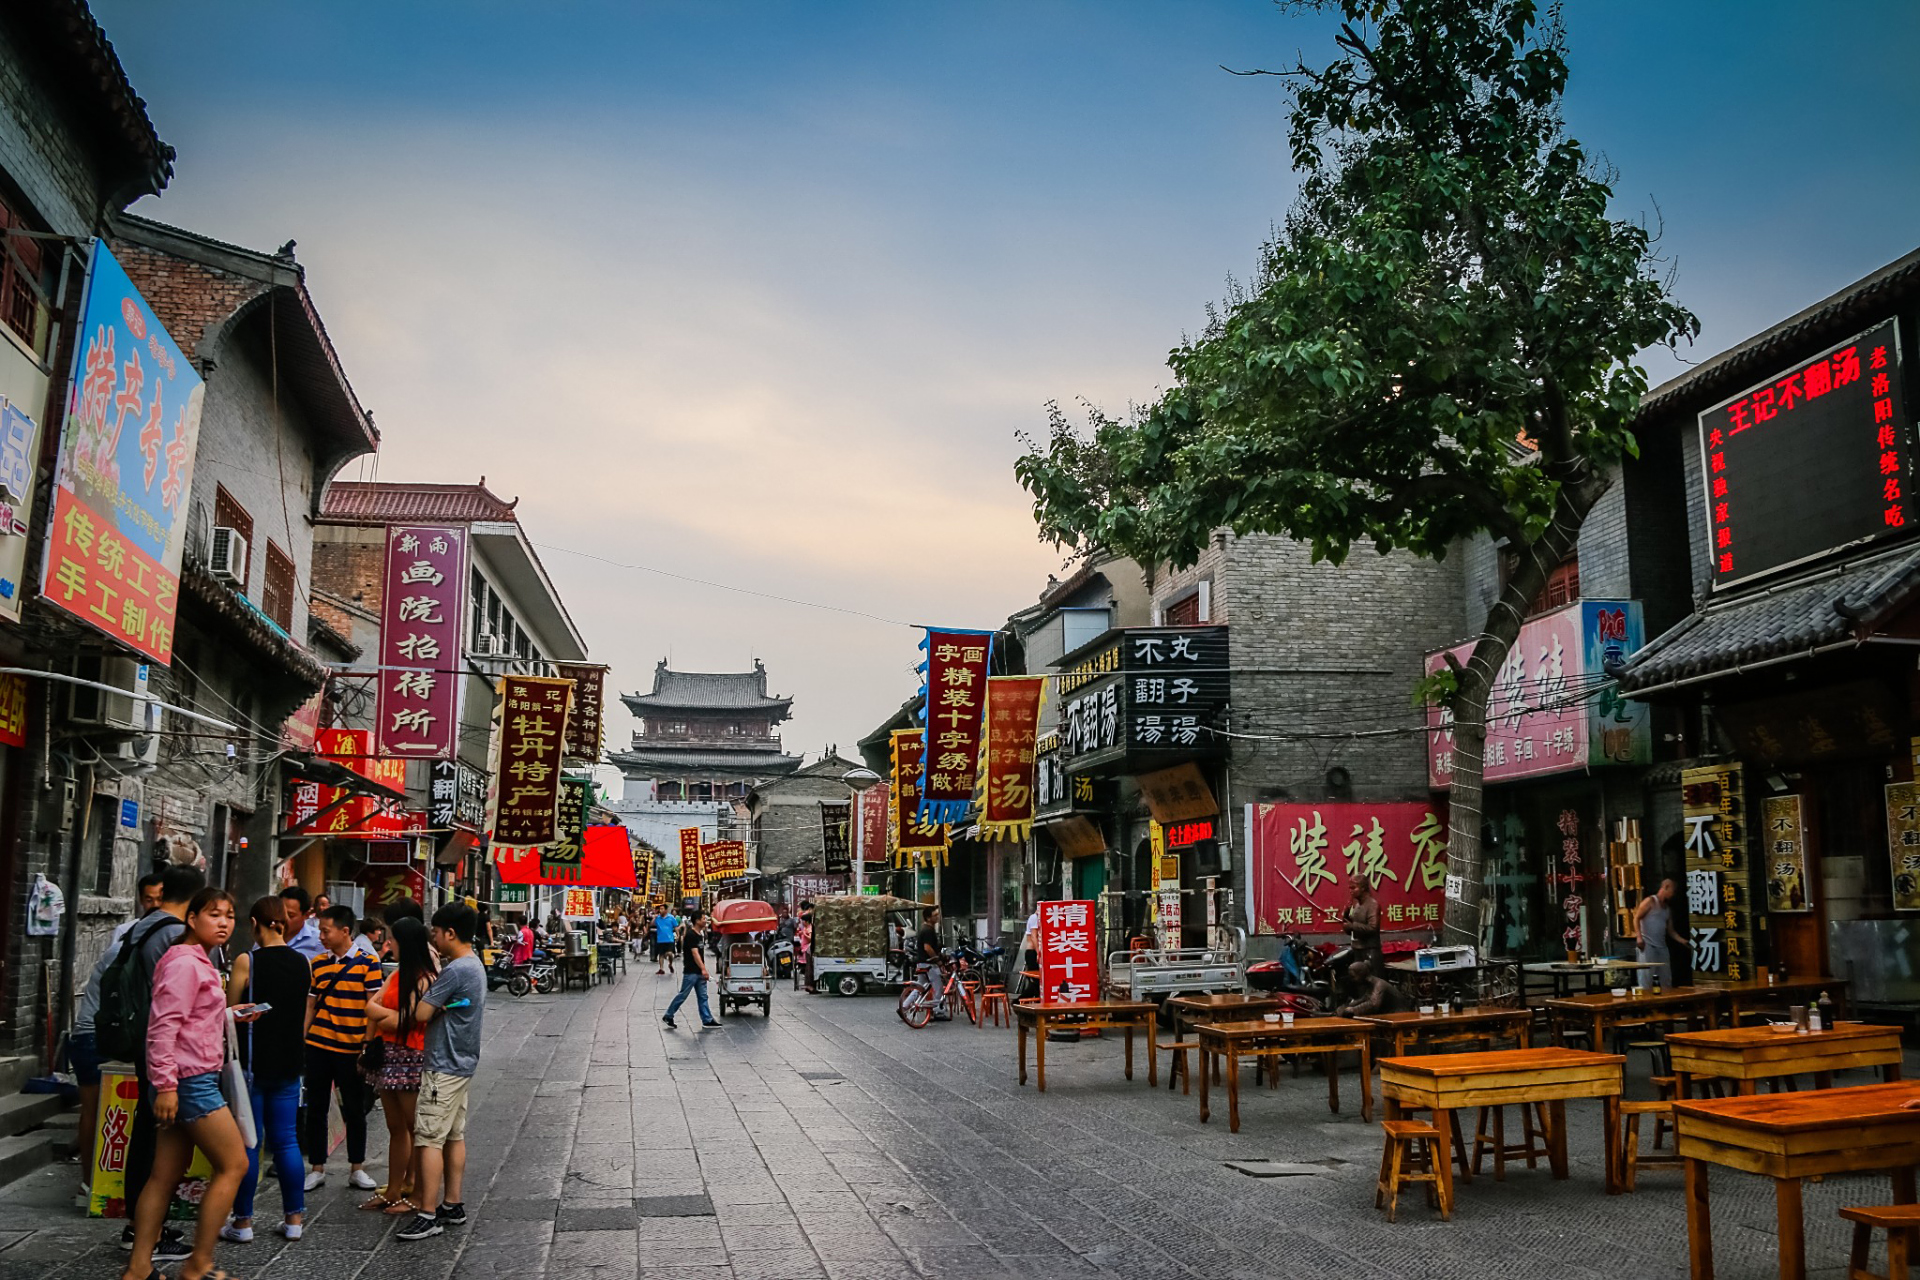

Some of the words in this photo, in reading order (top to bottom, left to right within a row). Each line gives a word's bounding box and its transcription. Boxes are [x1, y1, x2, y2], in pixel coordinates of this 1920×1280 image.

[80, 322, 188, 521] 特产专卖
[1727, 346, 1862, 437] 王记不翻汤
[1869, 345, 1904, 528] 老洛阳传统名吃
[398, 535, 448, 556] 新雨
[1709, 427, 1734, 574] 央视独家报道
[56, 556, 171, 655] 手工制作
[64, 505, 176, 615] 传统工艺
[391, 561, 444, 738] 画院招待所
[513, 686, 561, 701] 张记
[934, 643, 985, 664] 字画
[1134, 638, 1166, 745] 不翻湯
[1169, 635, 1200, 745] 丸子湯
[508, 698, 563, 714] 洛阳第一家
[582, 682, 598, 756] 加工各种佛珠
[936, 667, 976, 771] 精装十字绣
[508, 714, 556, 806] 牡丹特产
[930, 773, 975, 792] 做框
[992, 773, 1030, 808] 汤
[1074, 776, 1093, 802] 汤
[1289, 810, 1448, 896] 装裱店
[1718, 772, 1735, 867] 百年传承
[1771, 818, 1796, 876] 不翻汤
[1684, 815, 1720, 972] 不翻汤
[1722, 884, 1741, 981] 独家风味
[100, 1105, 130, 1172] 洛
